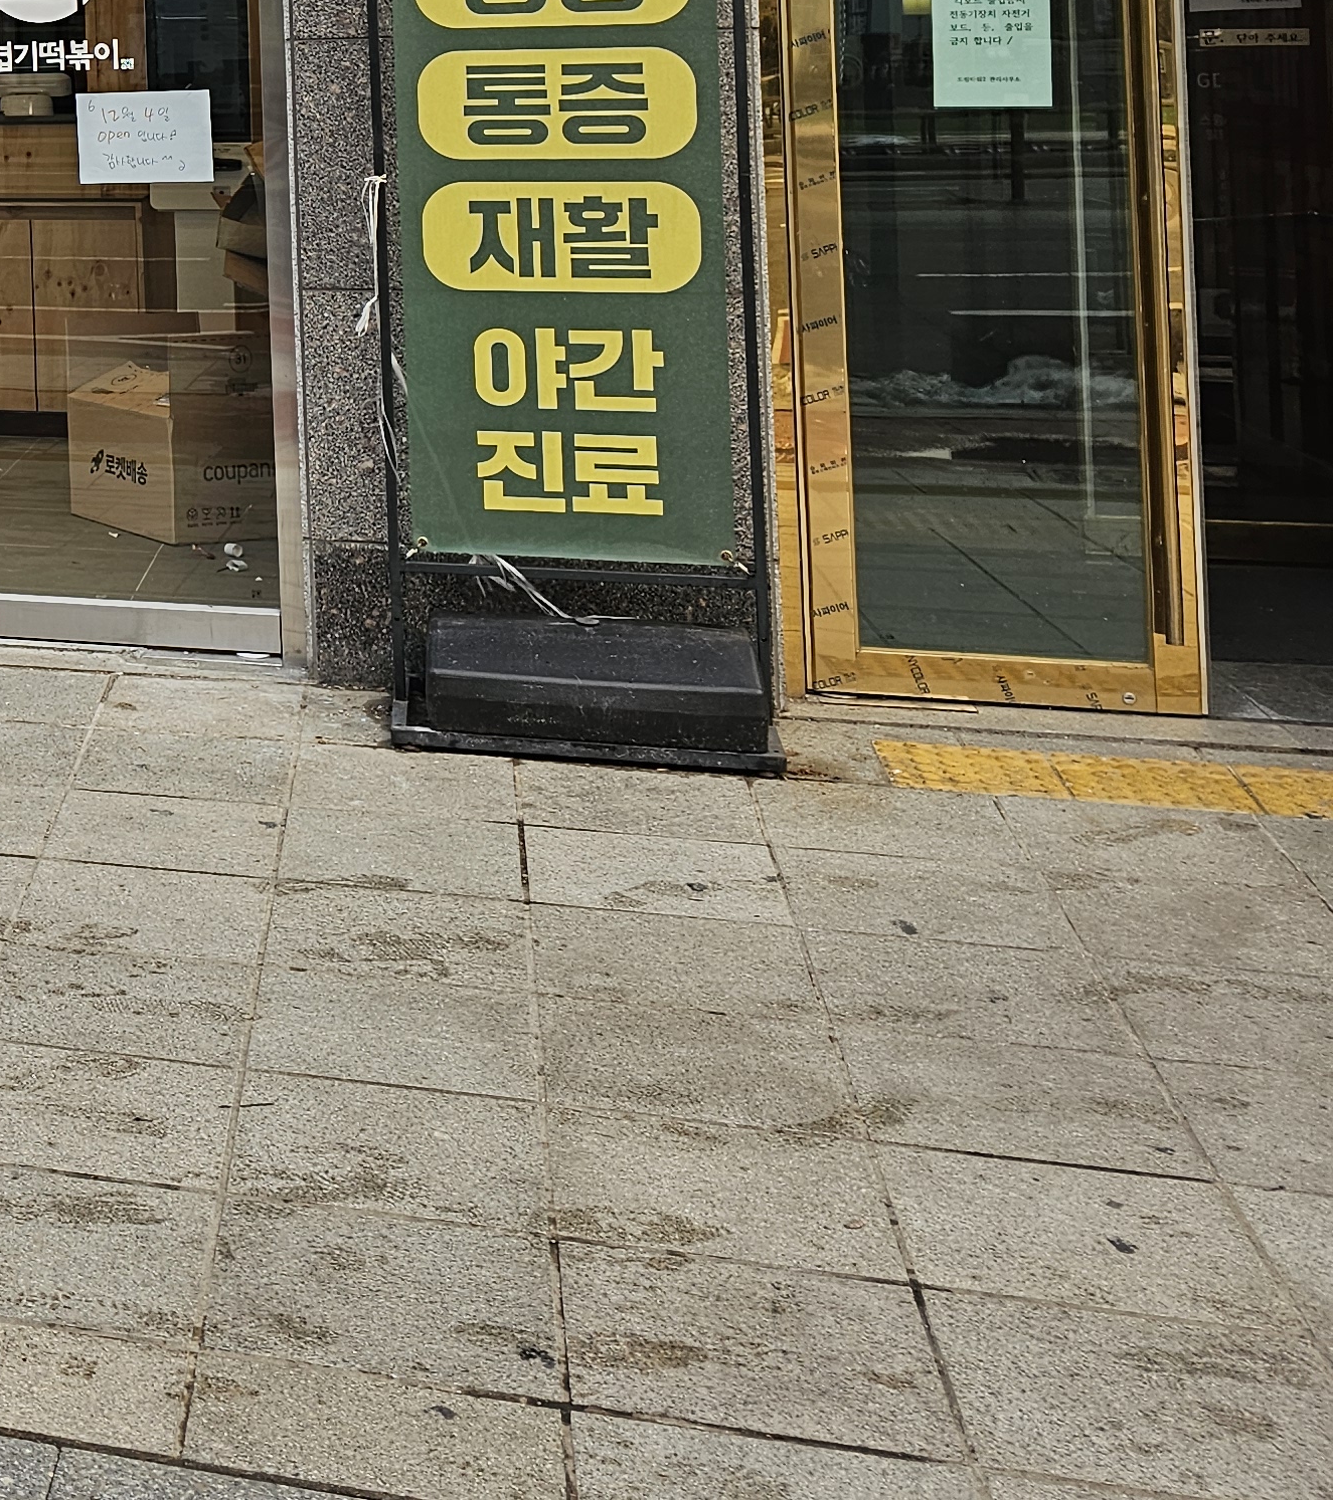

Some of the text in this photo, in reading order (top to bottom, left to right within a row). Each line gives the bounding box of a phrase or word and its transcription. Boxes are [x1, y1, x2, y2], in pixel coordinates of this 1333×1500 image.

[463, 61, 649, 146] 통증
[468, 195, 659, 280] 재활
[474, 327, 665, 413] 야간
[203, 462, 276, 485] coupan
[476, 430, 665, 516] 진료
